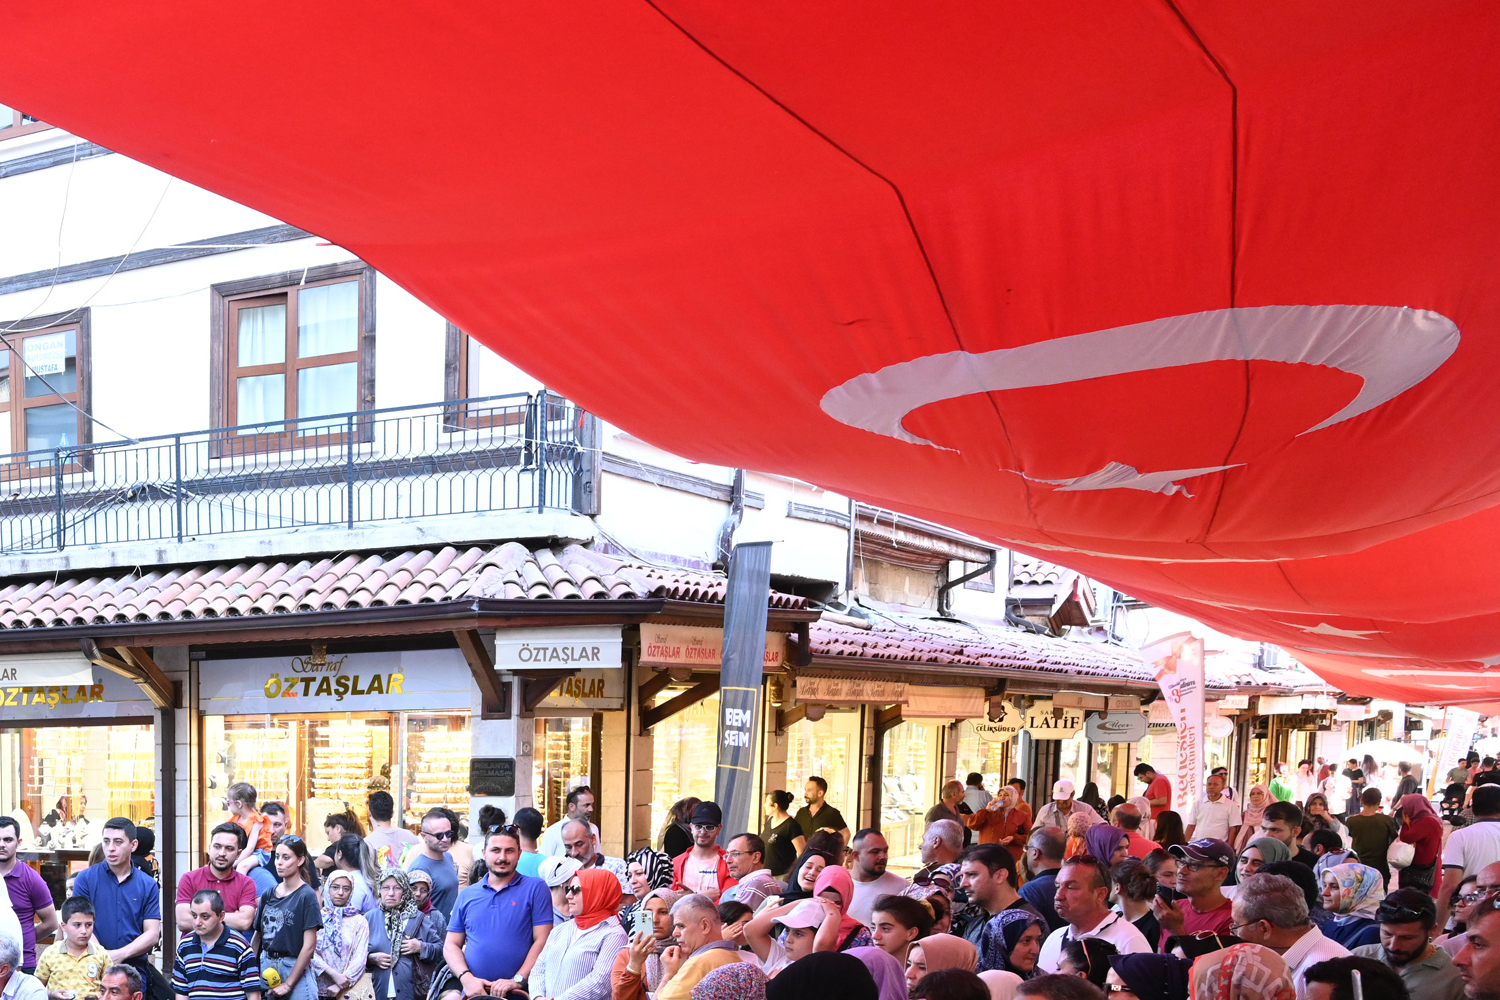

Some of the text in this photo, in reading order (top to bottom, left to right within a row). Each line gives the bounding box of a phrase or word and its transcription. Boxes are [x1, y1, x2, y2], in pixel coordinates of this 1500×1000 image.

[518, 644, 601, 664] ÖZTAŞLAR
[647, 645, 681, 661] ÖZTAŞLAR
[264, 673, 405, 702] ÖZTAŞLAR
[1029, 715, 1080, 729] LATİF
[87, 963, 98, 979] 9
